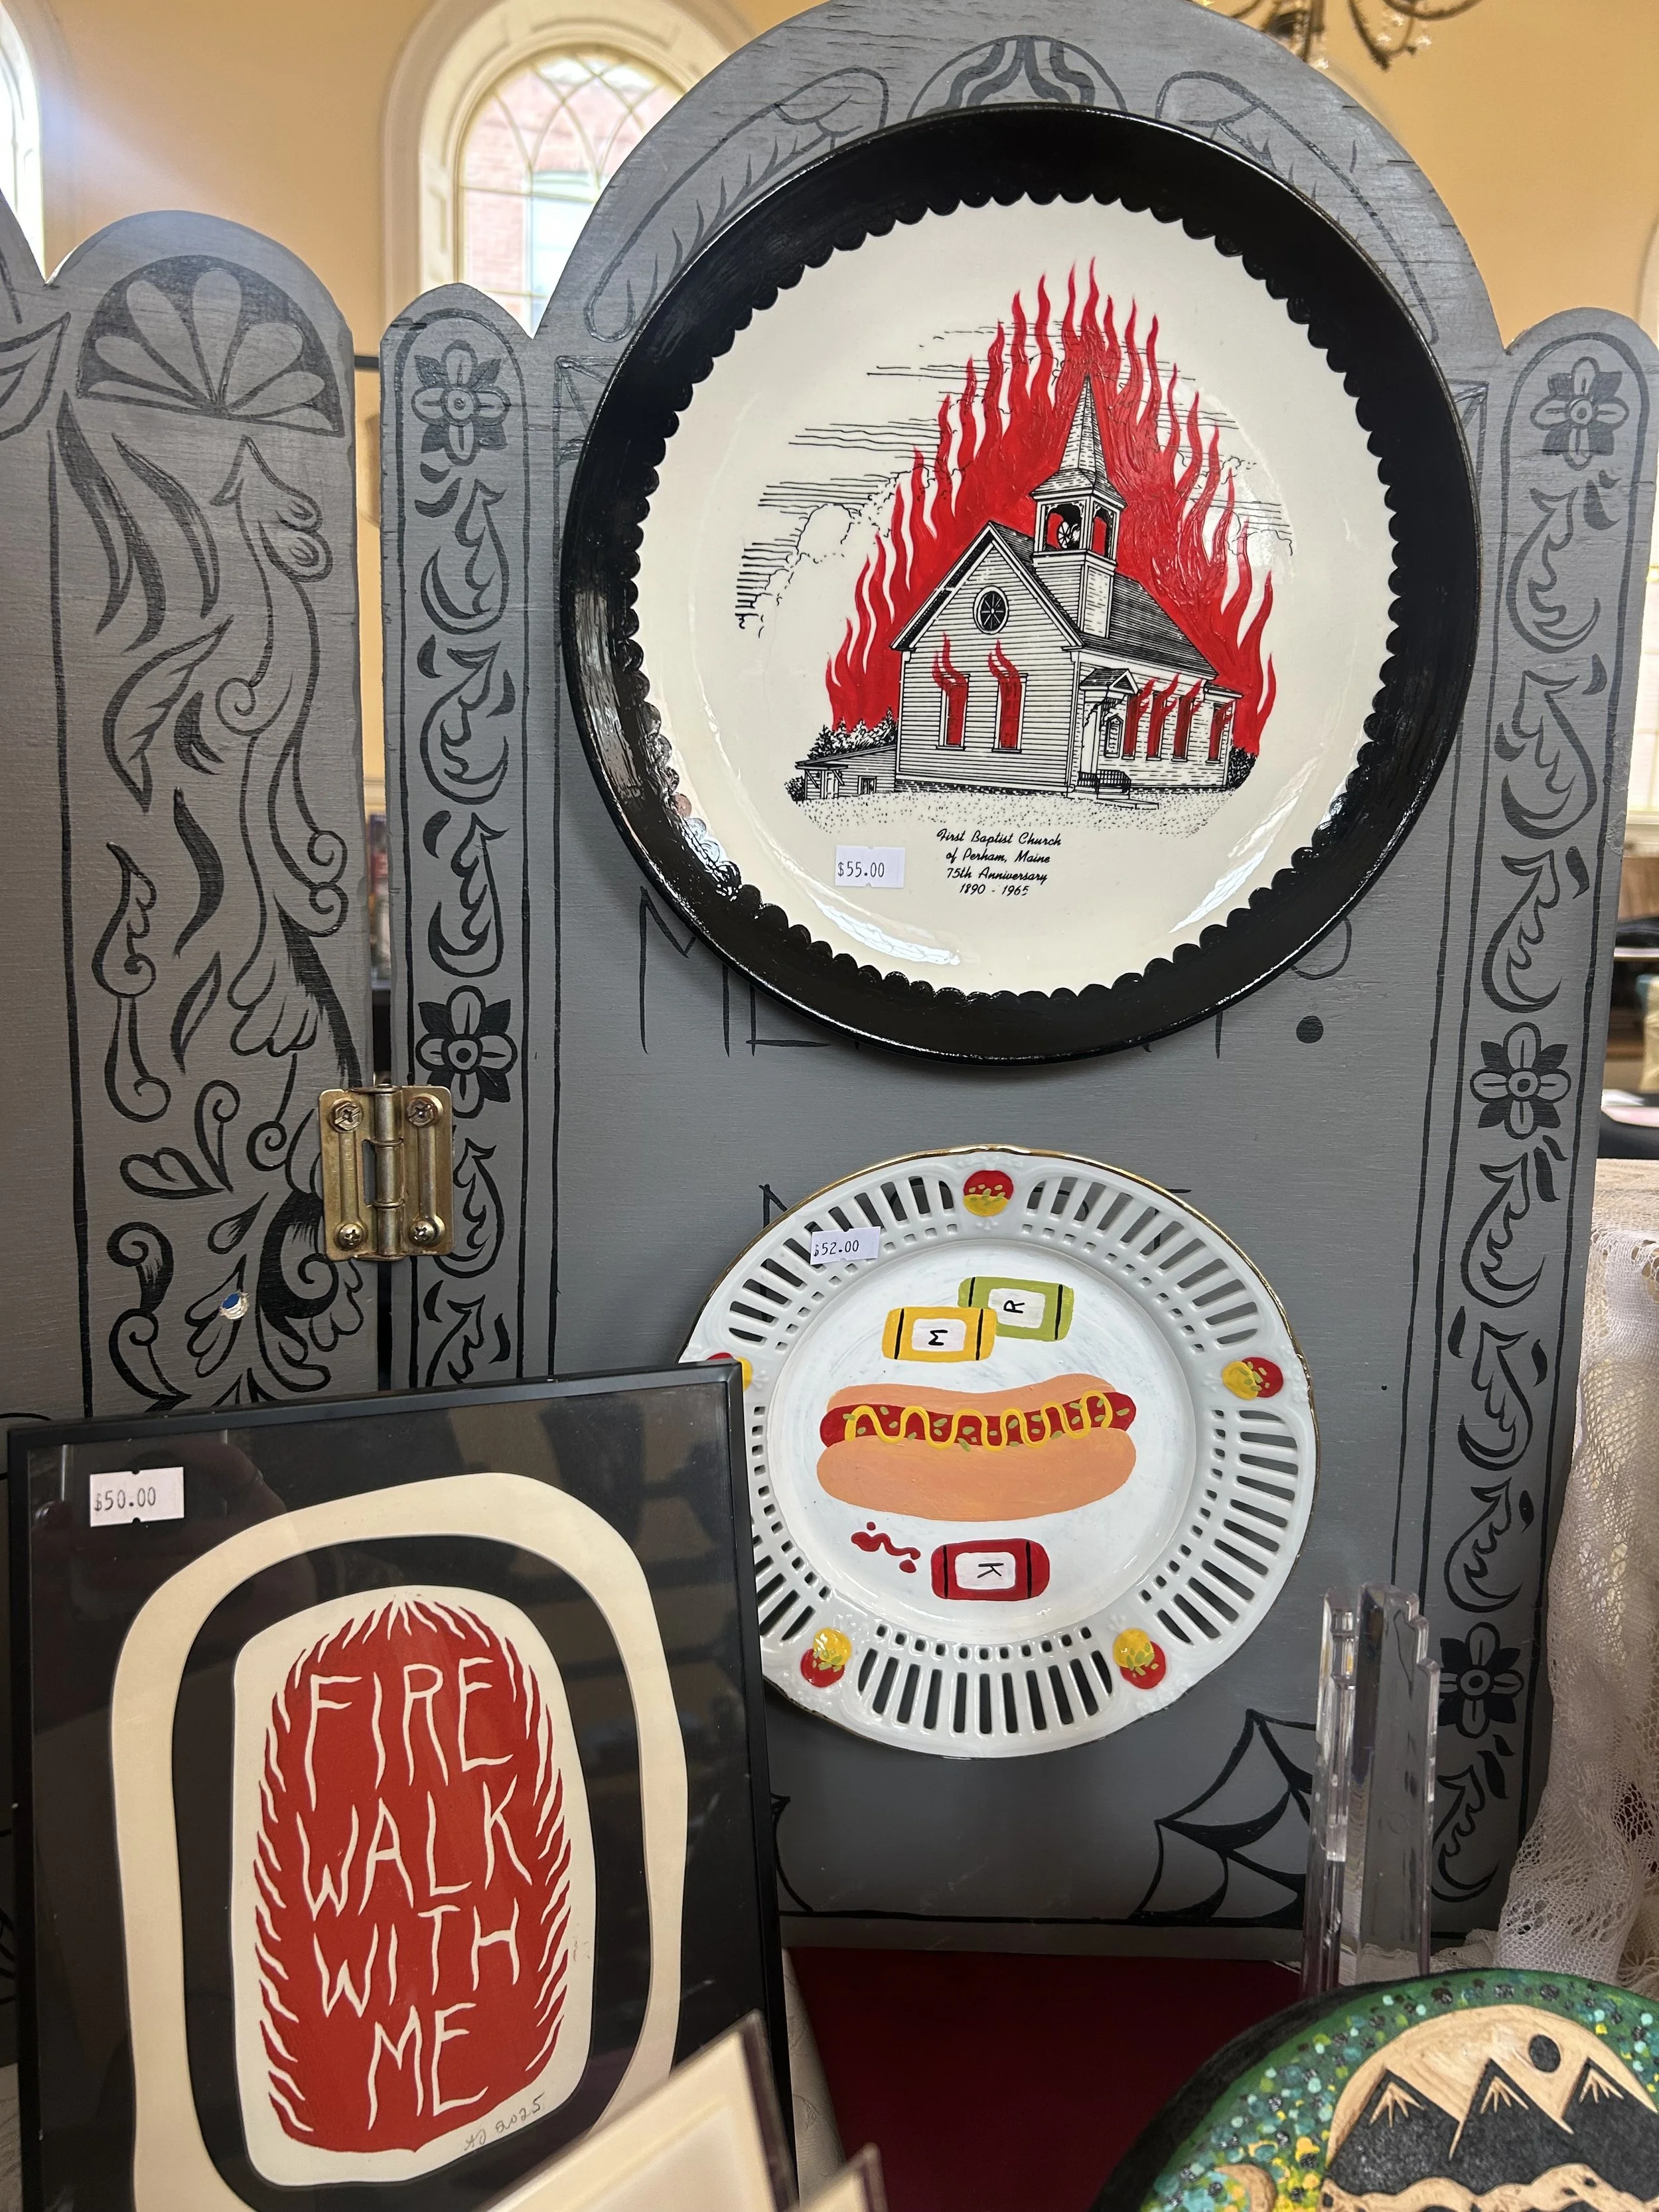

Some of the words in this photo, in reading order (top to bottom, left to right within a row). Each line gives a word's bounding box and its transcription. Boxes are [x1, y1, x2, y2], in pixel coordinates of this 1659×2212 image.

[936, 828, 966, 842] First
[971, 830, 1014, 848] Baptist
[1018, 832, 1062, 846] Church
[946, 847, 958, 863] of
[962, 848, 1007, 863] Perham,
[1014, 849, 1050, 863] Maine
[837, 861, 886, 879] $55.00
[946, 865, 972, 879] 75th
[978, 866, 1048, 885] Anniversary
[959, 883, 985, 895] 1890
[1001, 885, 1029, 896] 1965
[814, 1240, 859, 1256] $52.00
[1003, 1299, 1025, 1314] R
[928, 1329, 948, 1346] M
[94, 1487, 156, 1512] $50.00
[977, 1562, 1004, 1579] K
[305, 1657, 513, 1812] FIRE
[296, 1775, 532, 1921] WALK
[313, 1905, 520, 2018] WITH
[368, 2002, 488, 2130] ME
[495, 2092, 545, 2133] 2025
